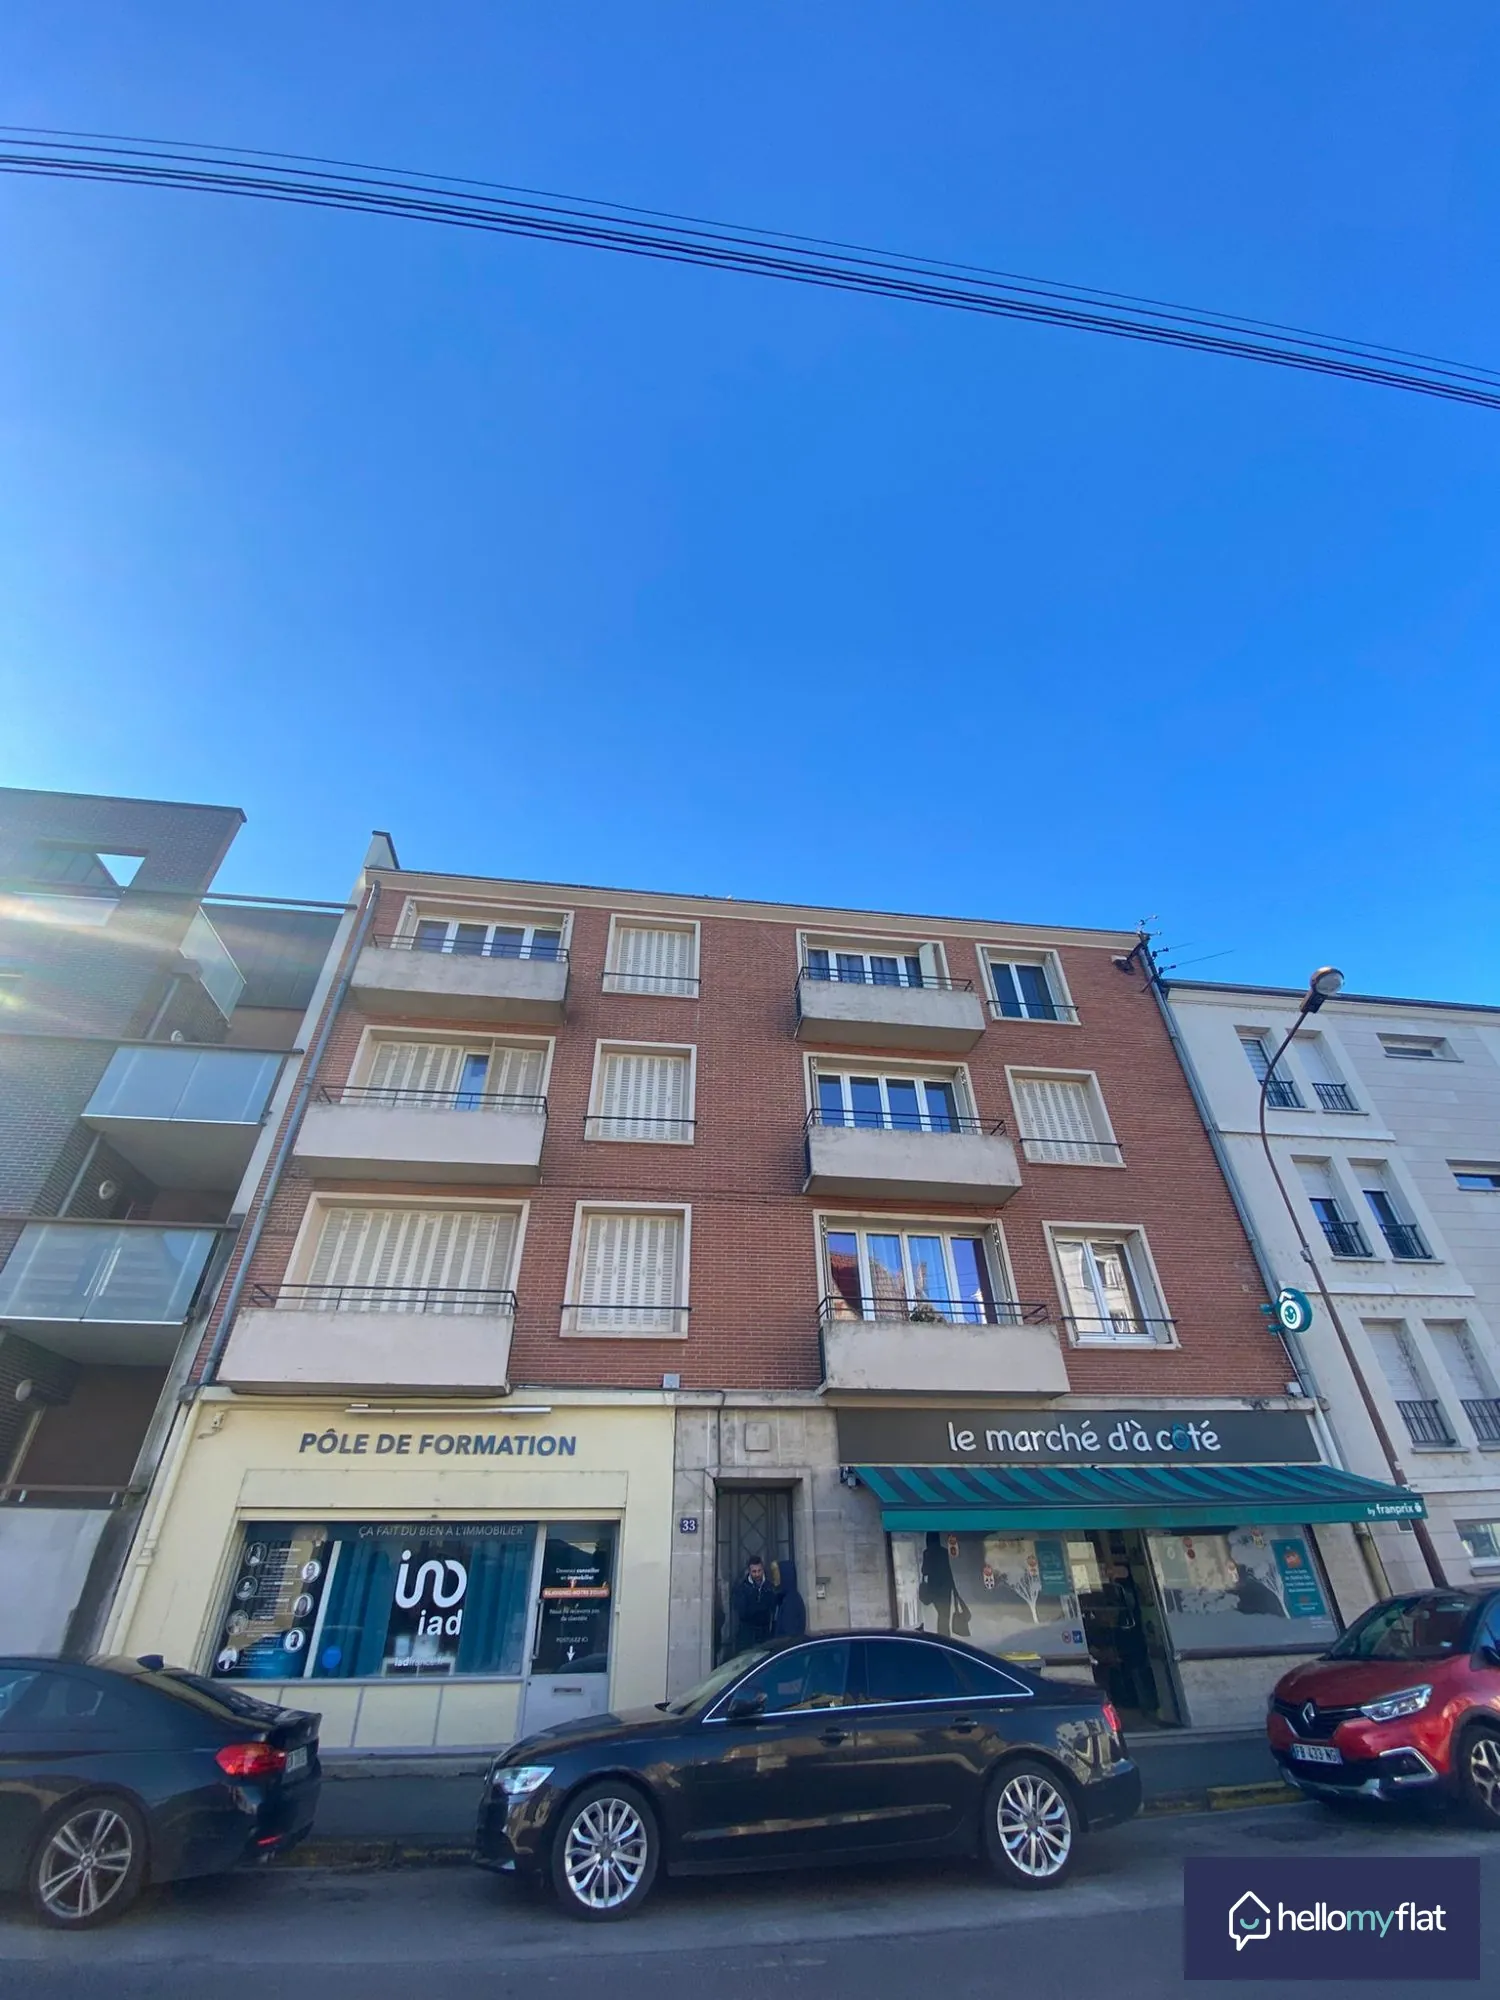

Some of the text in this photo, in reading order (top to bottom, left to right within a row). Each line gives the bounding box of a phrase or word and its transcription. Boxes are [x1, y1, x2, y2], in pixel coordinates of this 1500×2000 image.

[299, 1428, 576, 1456] PÔLE DE FORMATION
[948, 1419, 1220, 1452] le marché d'à côté
[1367, 1503, 1414, 1516] by franprix
[358, 1526, 374, 1538] ÇA
[376, 1526, 399, 1536] FAIT
[400, 1526, 416, 1536] DU
[419, 1526, 443, 1536] BIEN
[455, 1525, 524, 1536] L'IMMOBILIER
[682, 1519, 695, 1531] 33
[418, 1608, 463, 1636] iad
